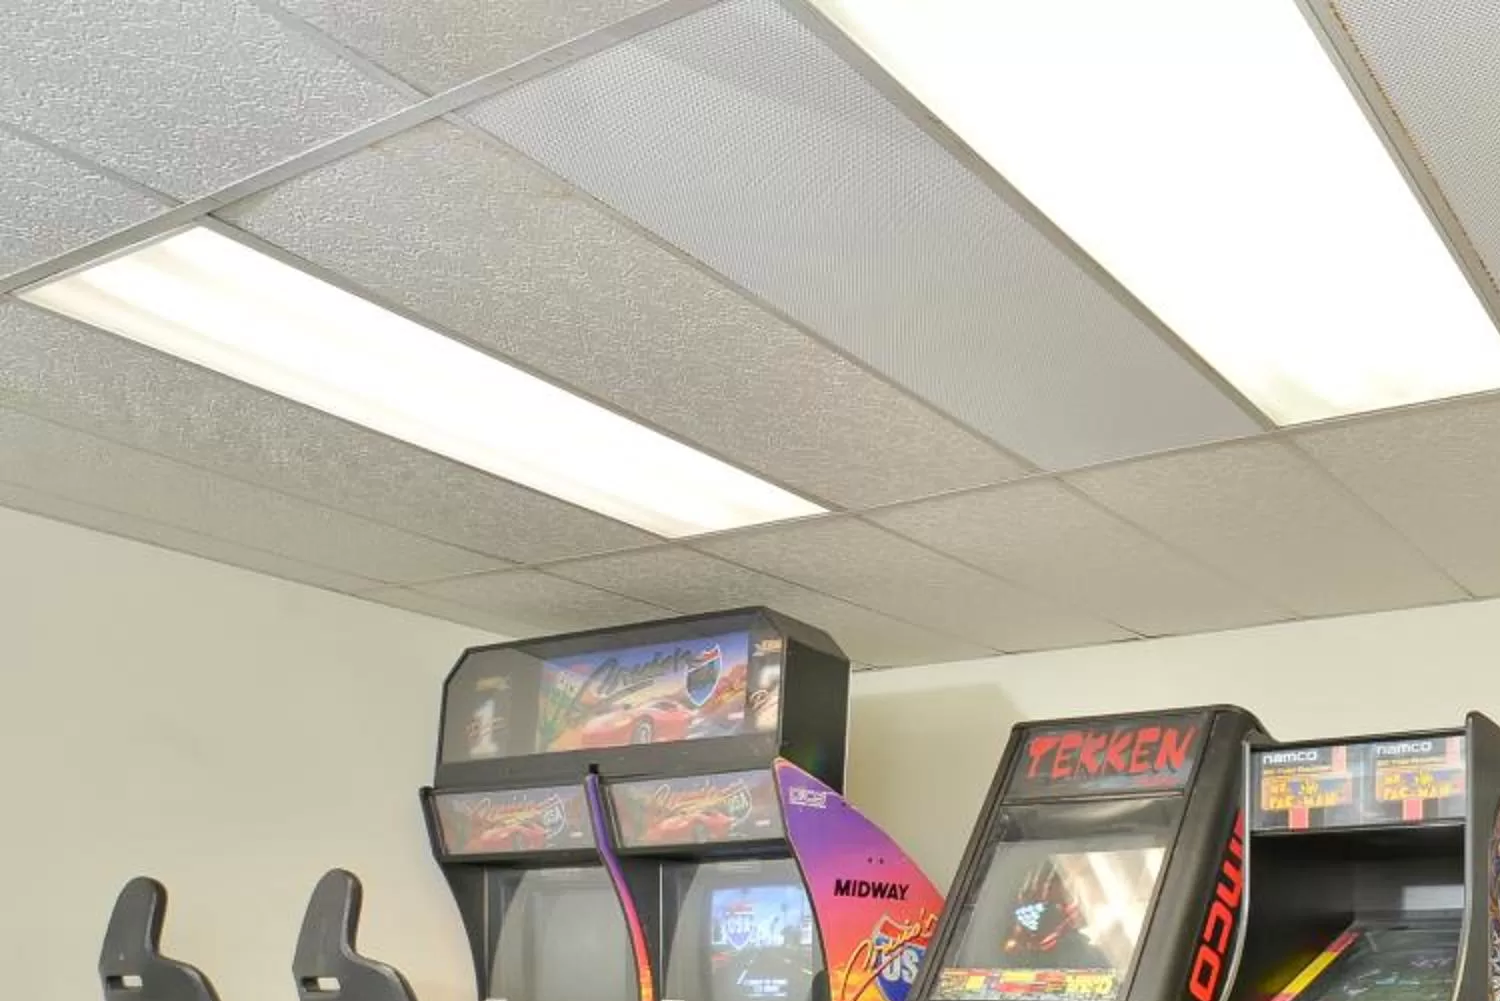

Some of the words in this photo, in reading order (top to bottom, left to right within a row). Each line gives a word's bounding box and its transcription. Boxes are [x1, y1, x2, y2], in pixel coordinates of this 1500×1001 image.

[1027, 725, 1198, 780] TEKKEN
[1376, 741, 1433, 756] namco
[1263, 751, 1318, 765] namco
[833, 878, 910, 900] MIDWAY
